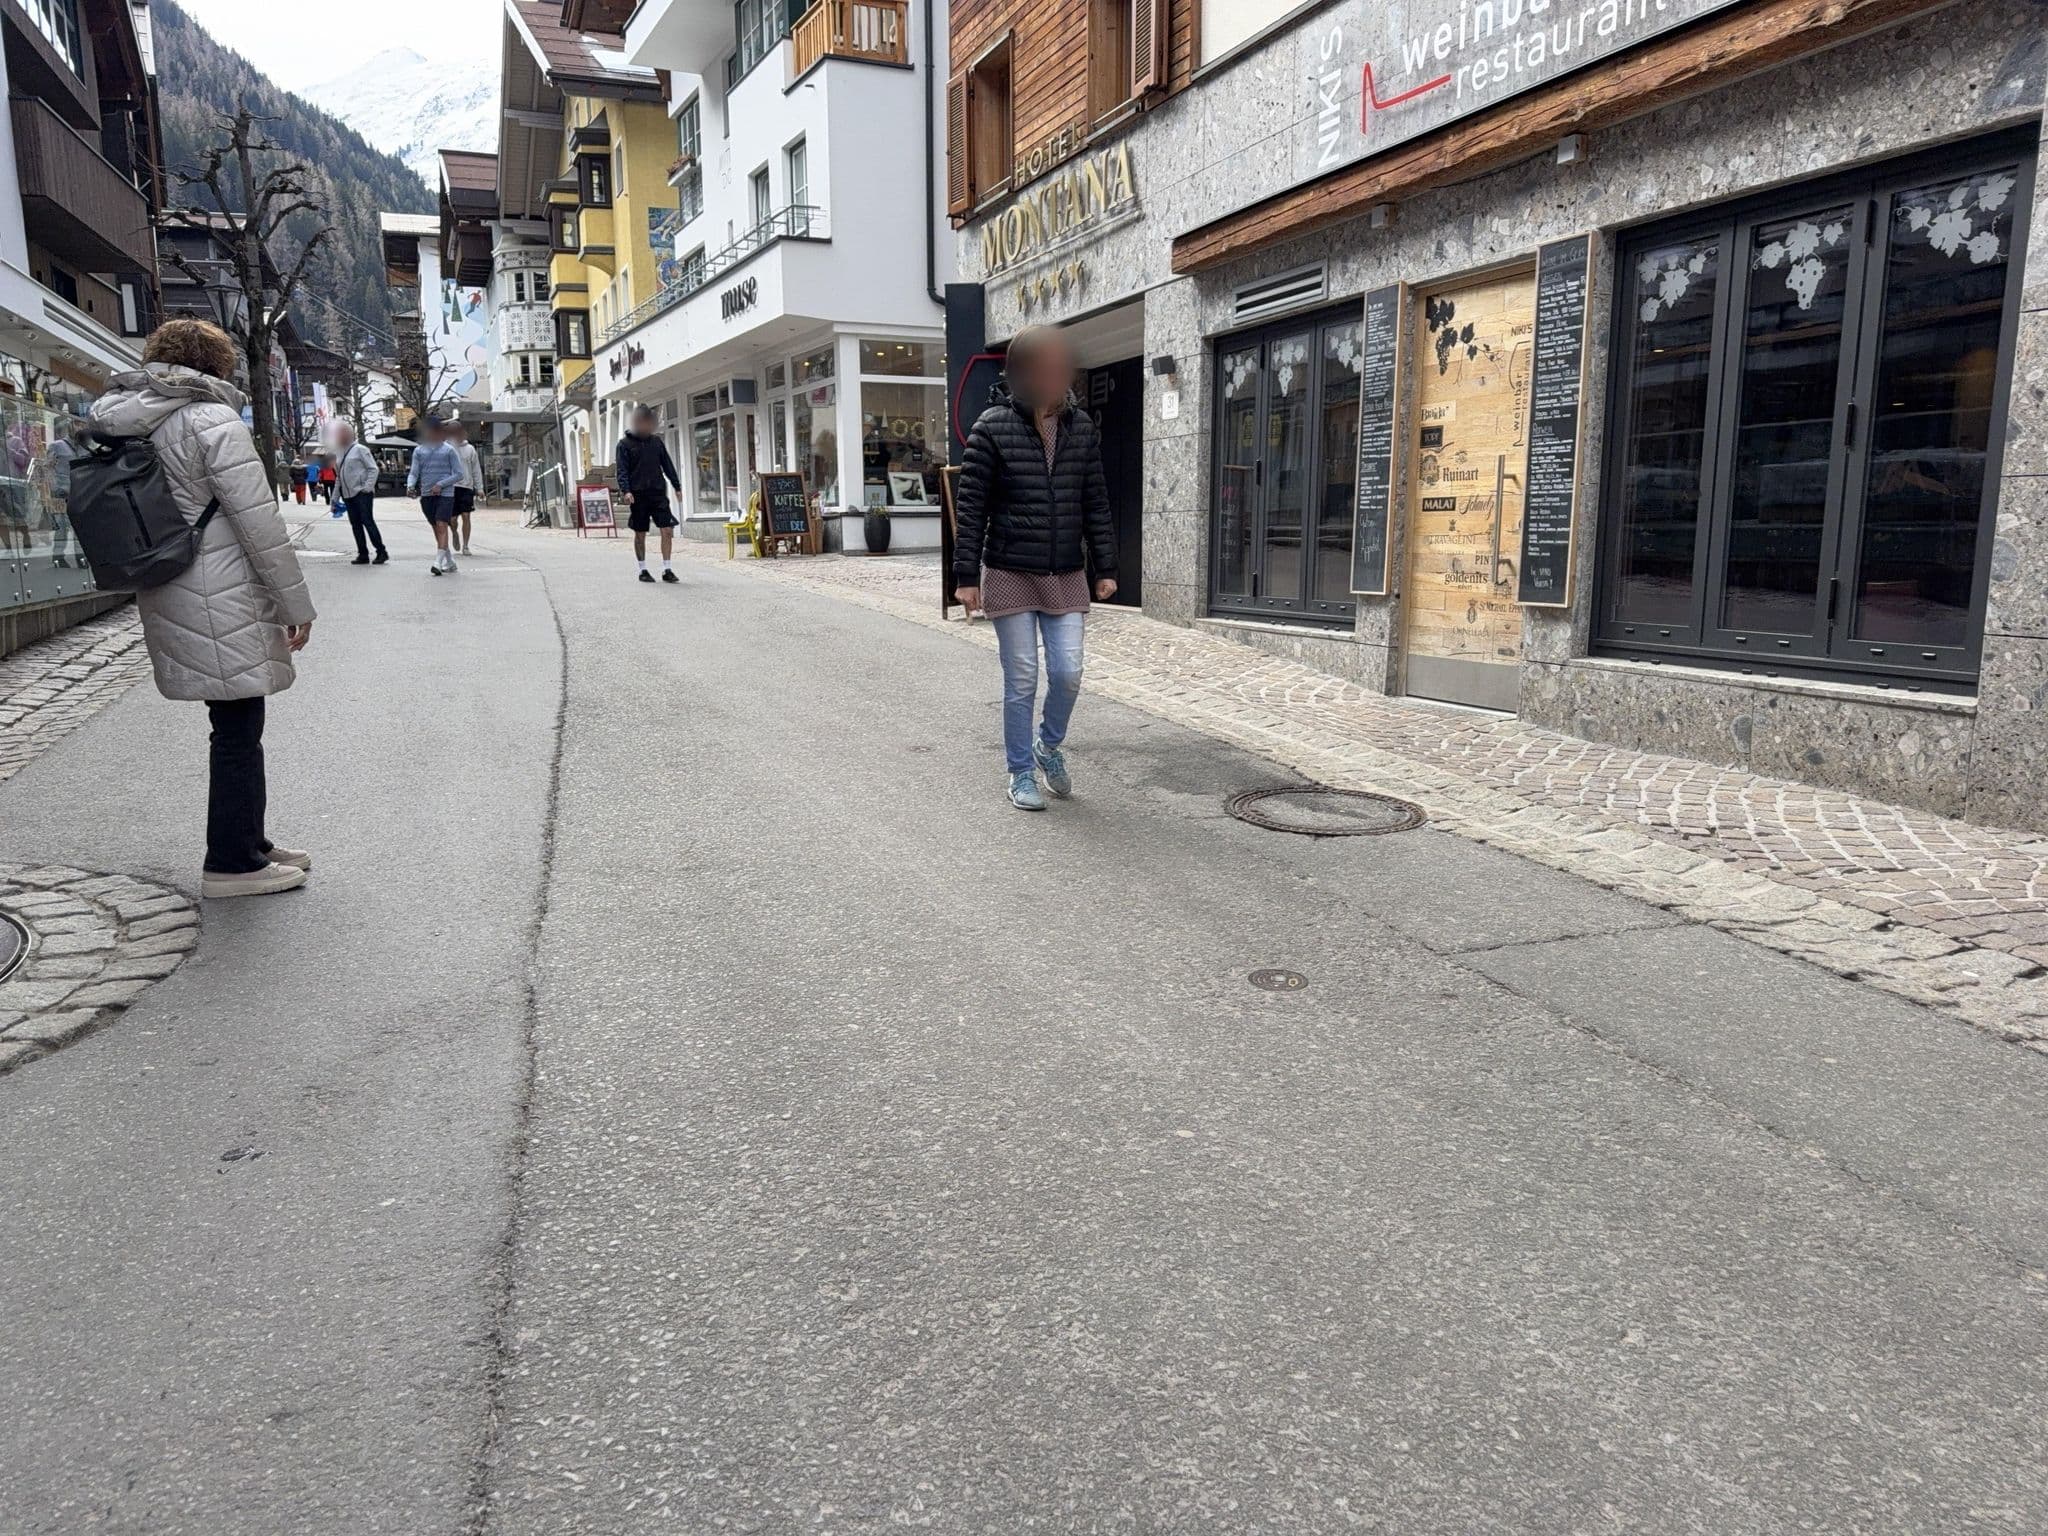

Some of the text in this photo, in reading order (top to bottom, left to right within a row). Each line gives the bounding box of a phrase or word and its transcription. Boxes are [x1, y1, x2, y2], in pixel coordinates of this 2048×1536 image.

[1317, 26, 1343, 169] NIKI'S
[1014, 122, 1087, 186] HOTEL
[981, 140, 1136, 277] MONTANA
[720, 276, 757, 320] muse
[1512, 373, 1523, 431] weinbar
[1442, 467, 1479, 482] Ruinart
[1424, 500, 1454, 510] MALAT
